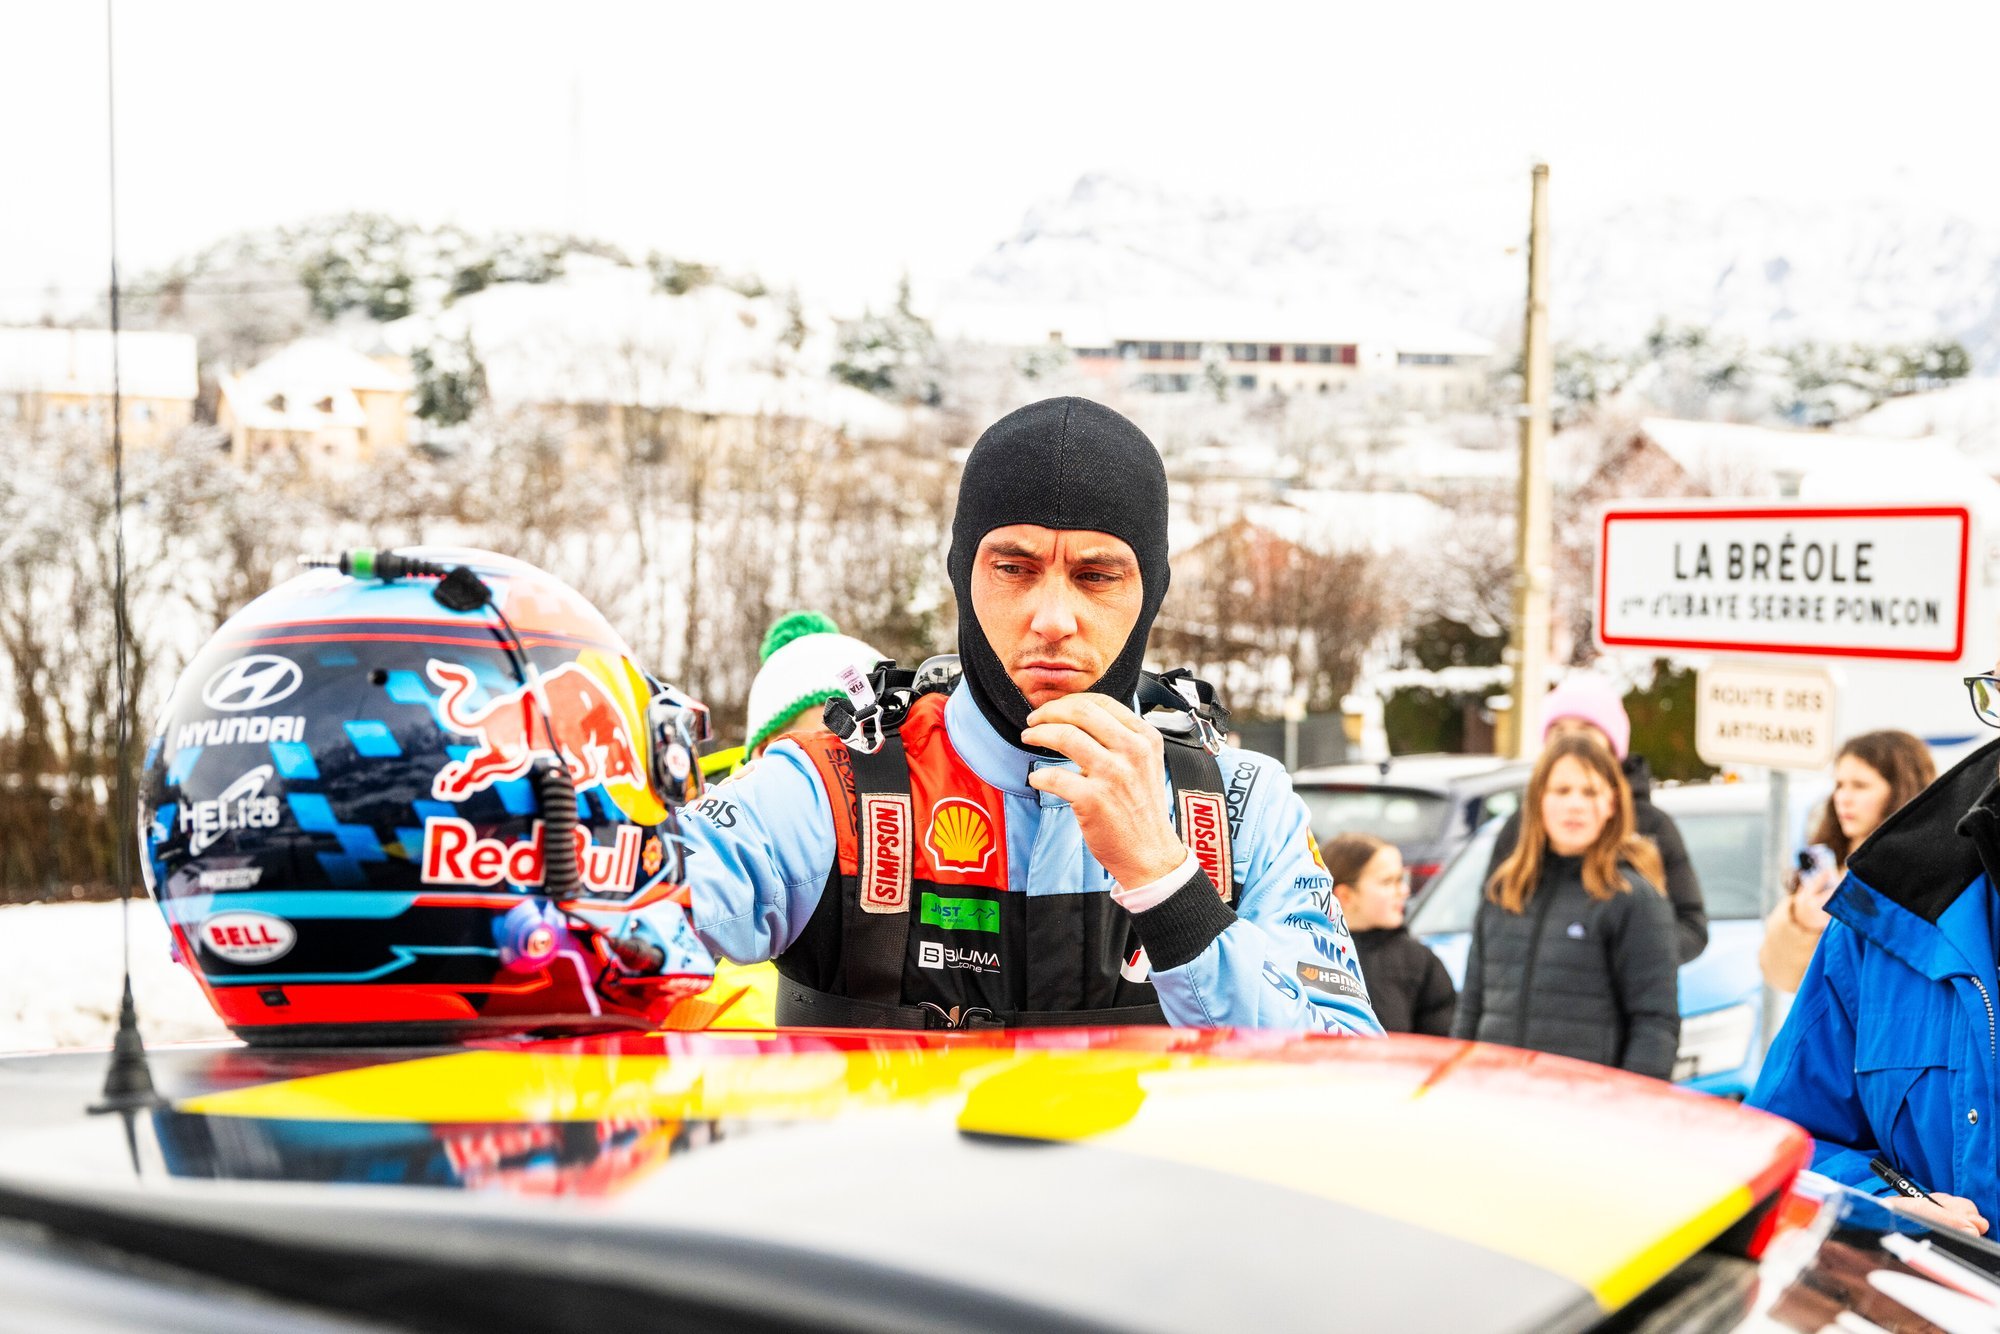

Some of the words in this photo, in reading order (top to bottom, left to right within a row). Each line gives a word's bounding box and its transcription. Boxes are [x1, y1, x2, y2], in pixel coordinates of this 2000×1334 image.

[1674, 542, 1713, 581] LA
[1728, 532, 1874, 583] BRÉOLE
[1749, 595, 1826, 624] SERRE
[1834, 597, 1941, 627] PONÇON
[849, 681, 865, 694] FIA
[1710, 686, 1774, 709] ROUTE
[1784, 689, 1824, 712] DES
[176, 715, 307, 750] HYUNDAI
[1717, 721, 1815, 747] ARTISANS
[426, 818, 545, 886] Red
[875, 807, 899, 900] SIMPSON
[210, 925, 279, 946] BELL
[945, 948, 1000, 967] BUMA
